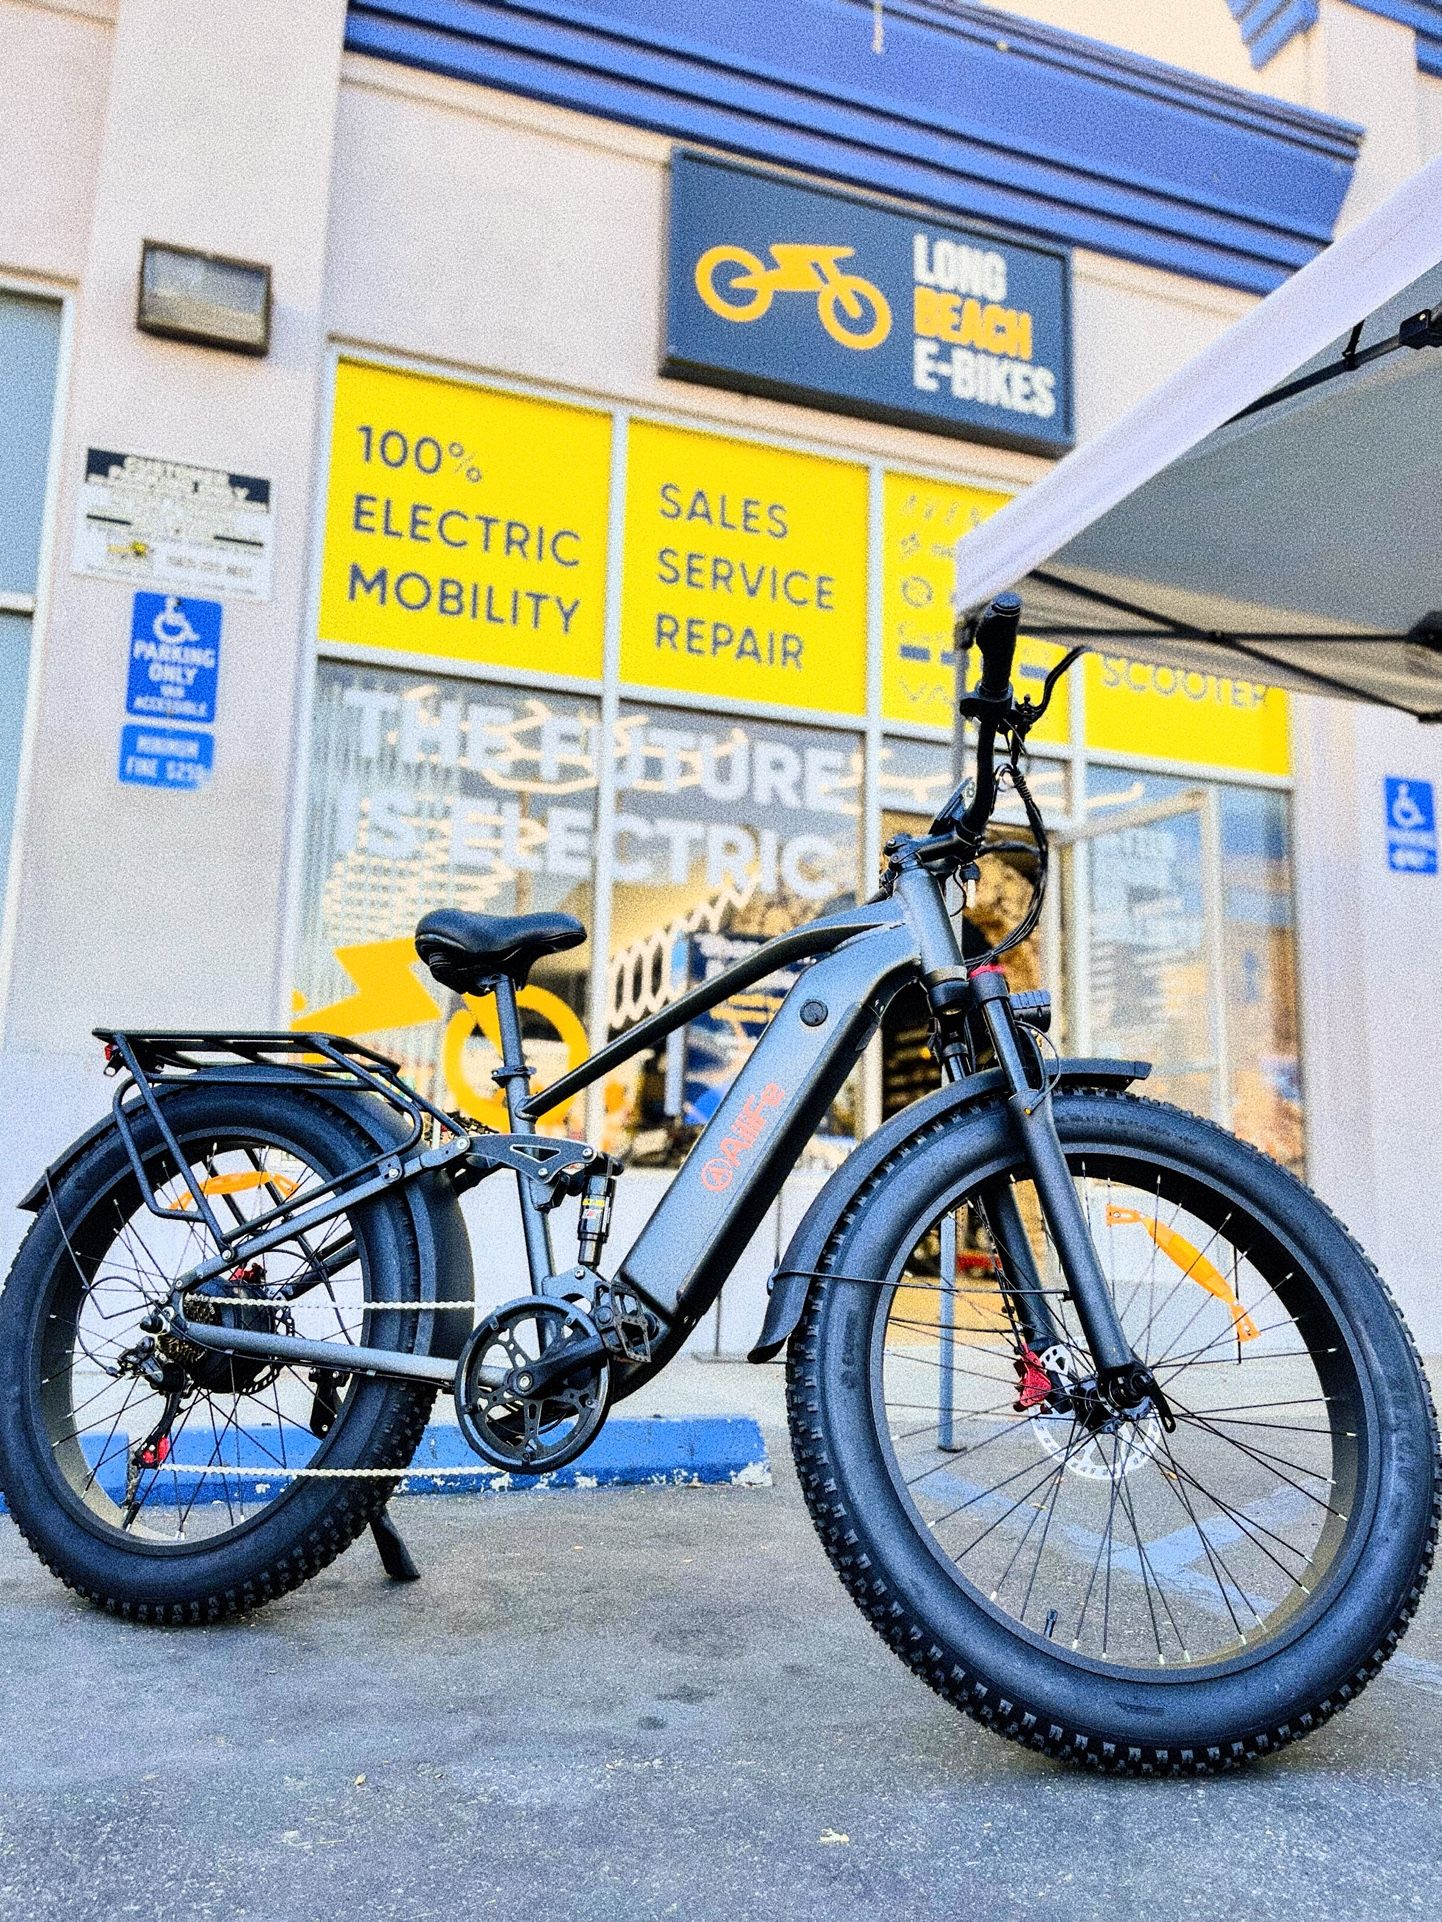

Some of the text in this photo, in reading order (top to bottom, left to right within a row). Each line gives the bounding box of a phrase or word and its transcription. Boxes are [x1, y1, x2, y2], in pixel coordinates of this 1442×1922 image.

[913, 233, 1008, 302] LONG
[913, 285, 1034, 361] BEACH
[913, 338, 1056, 418] E-BIKES
[356, 425, 482, 483] 100%
[353, 492, 580, 567] ELECTRIC
[659, 482, 789, 539] SALES
[348, 561, 581, 634] MOBILITY
[657, 547, 835, 611] SERVICE
[133, 639, 216, 669] PARKING
[148, 662, 199, 686] ONLY
[656, 612, 804, 671] REPAIR
[344, 688, 852, 813] THE FUTURE
[337, 781, 836, 900] IS ELECTRIC
